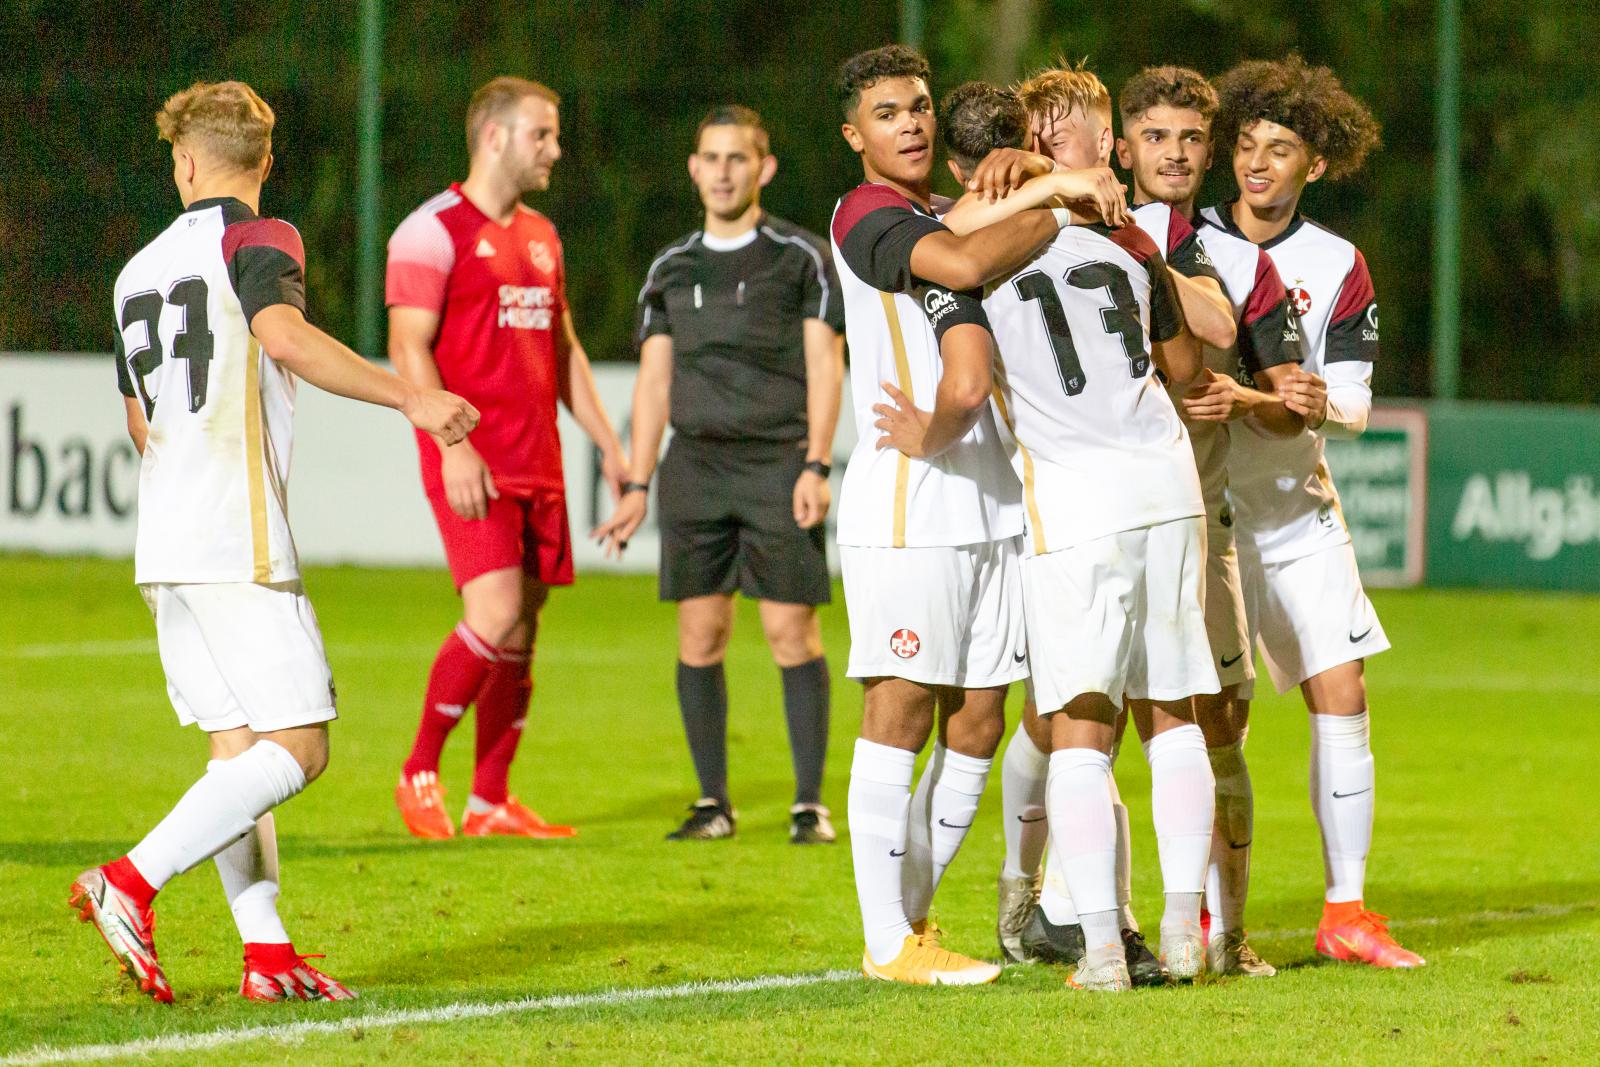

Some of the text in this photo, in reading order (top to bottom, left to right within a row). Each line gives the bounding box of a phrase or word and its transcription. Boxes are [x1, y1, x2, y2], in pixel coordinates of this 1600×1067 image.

[121, 275, 214, 423] 27
[928, 291, 956, 312] IKK
[1011, 260, 1150, 396] 17
[1452, 469, 1600, 560] Allgä
